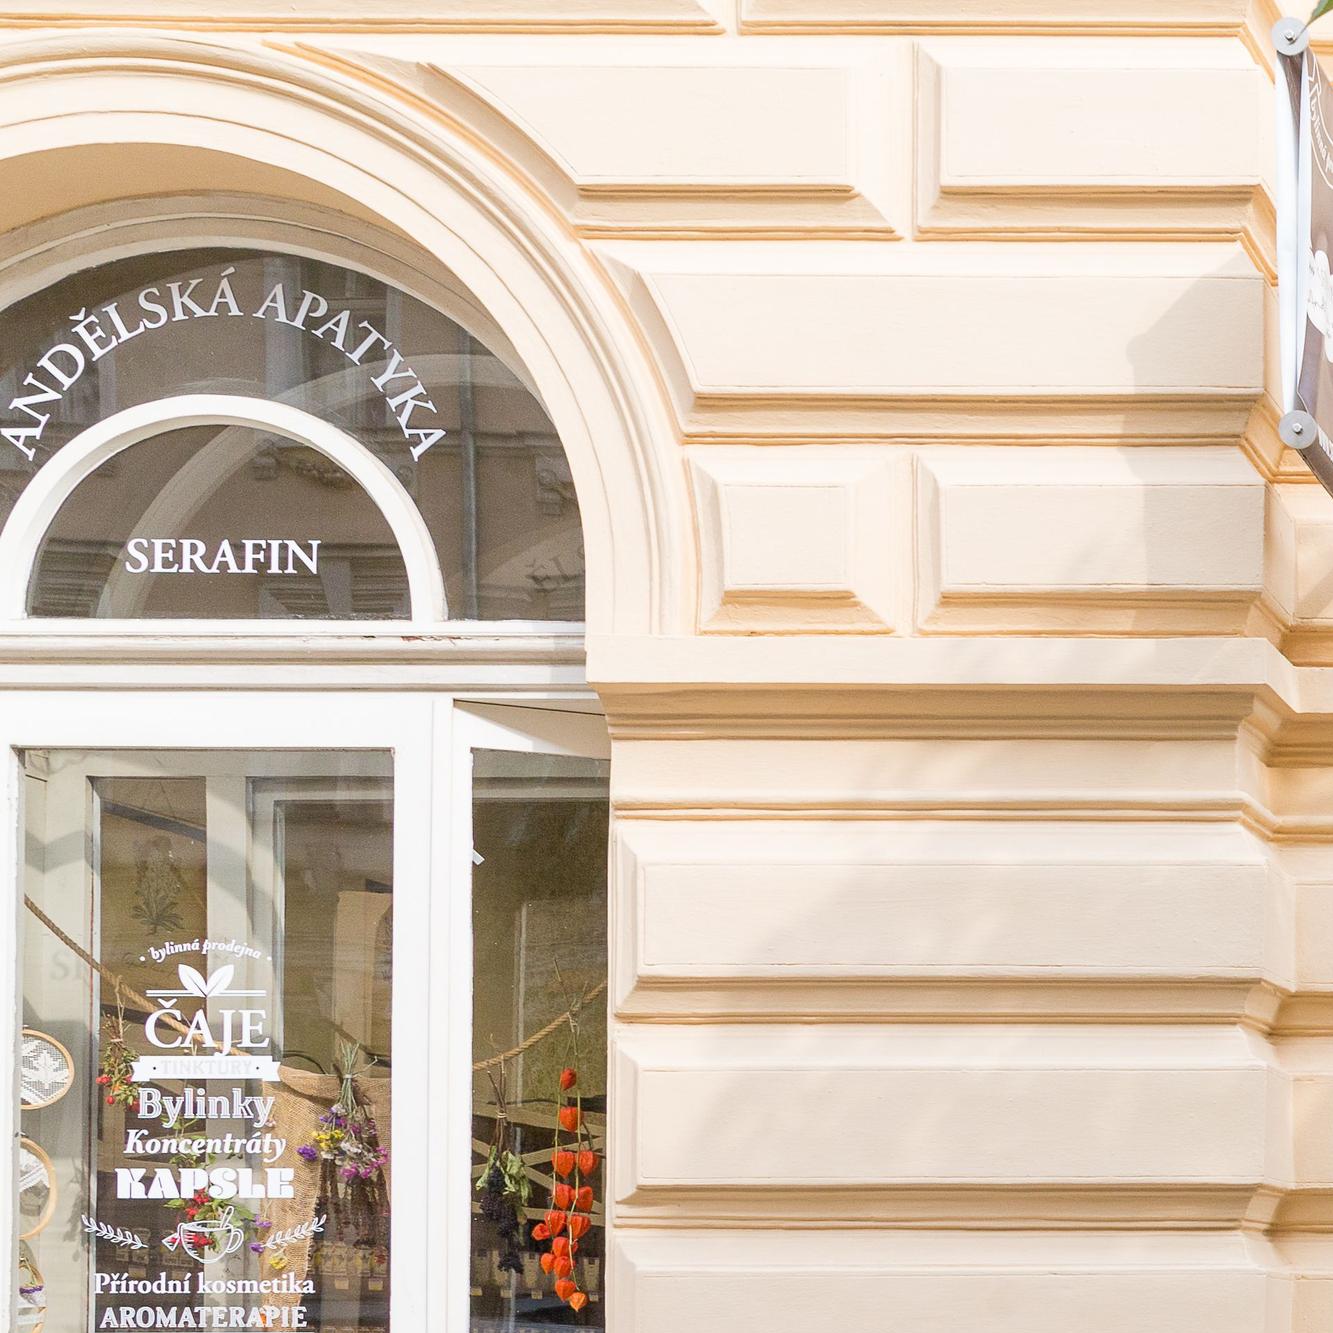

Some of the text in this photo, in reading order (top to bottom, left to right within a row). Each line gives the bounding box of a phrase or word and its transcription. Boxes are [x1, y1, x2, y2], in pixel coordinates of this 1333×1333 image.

[0, 266, 448, 463] ANDĚLSKÁ APATYKA
[124, 538, 321, 575] SERAFIN
[148, 938, 261, 961] bylinná prodejna
[144, 998, 270, 1057] ČAJE
[160, 1060, 253, 1076] TINKTURY
[137, 1088, 275, 1128] Bylinky
[123, 1129, 287, 1163] Koncentráty
[114, 1168, 295, 1199] KAPSLE
[94, 1272, 315, 1295] Přírodní kosmetika
[99, 1306, 308, 1329] AROMATERAPIE
